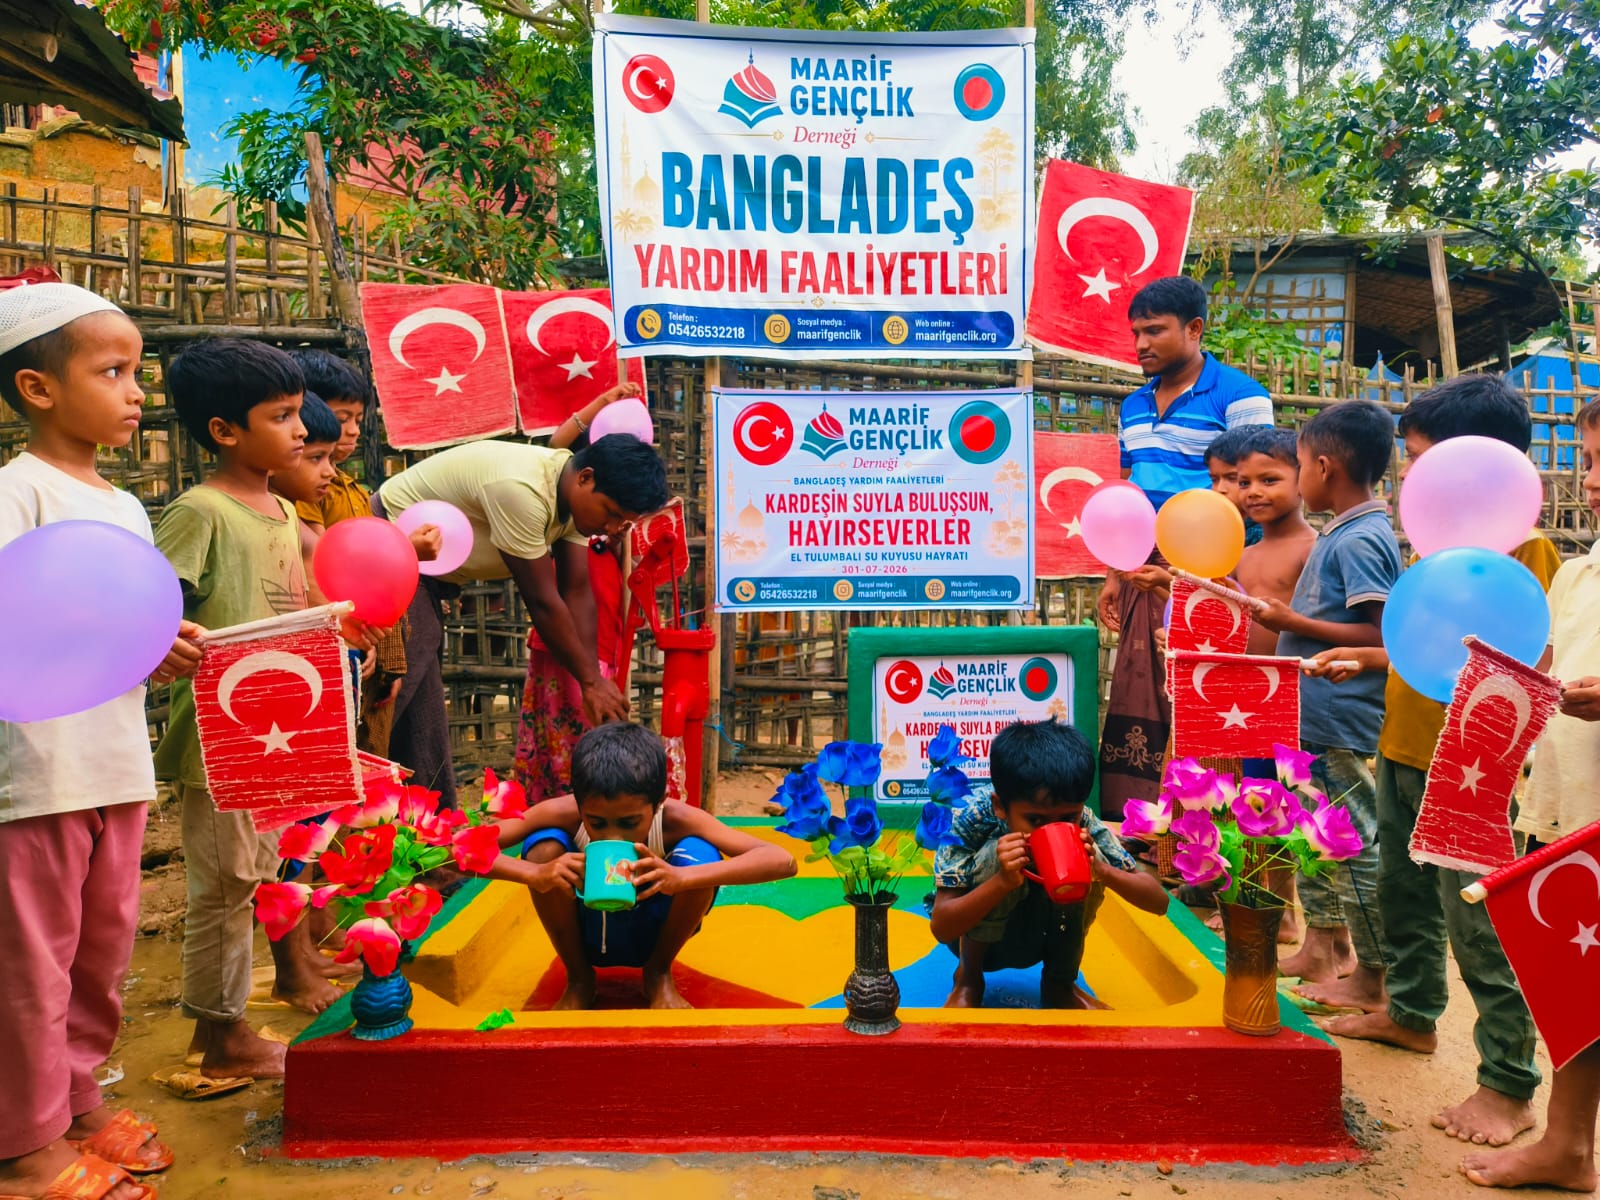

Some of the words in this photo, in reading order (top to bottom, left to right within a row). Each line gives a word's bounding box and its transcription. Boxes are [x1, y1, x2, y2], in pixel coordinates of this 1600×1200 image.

[790, 54, 893, 82] MAARİF
[790, 81, 915, 124] GENÇLİK
[793, 126, 857, 150] Derneği
[661, 151, 975, 246] BANGLADEŞ
[633, 243, 768, 294] YARDIM
[781, 242, 1009, 296] FAALİYETLERİ
[668, 311, 694, 322] Telefon
[797, 317, 820, 328] Sosyal
[821, 318, 842, 328] medya
[915, 319, 930, 328] Web
[930, 319, 950, 328] online
[668, 322, 746, 340] 05426532218
[797, 329, 862, 342] maarifgenclik
[915, 330, 997, 344] maarifgenclik.org
[849, 403, 930, 425] MAARİF
[850, 425, 944, 456] GENÇLİK
[852, 456, 899, 472] Derneği
[793, 477, 847, 487] BANGLADEŞ
[849, 476, 883, 485] YARDIM
[886, 474, 944, 485] FAALİYETLERİ
[765, 488, 848, 518] KARDEŞİN
[853, 491, 904, 513] SUYLA
[909, 491, 994, 518] BULUŞSUN,
[788, 518, 972, 547] HAYIRSEVERLER
[790, 553, 802, 562] EL
[805, 552, 861, 562] TULUMBALI
[865, 552, 878, 561] SU
[881, 551, 922, 561] KUYUSU
[925, 551, 968, 561] HAYRATI
[841, 565, 908, 574] 301-07-2026
[760, 589, 818, 600] 05426532218
[858, 589, 908, 600] maarifgenclik
[951, 588, 1012, 599] maarifgenclik.org
[957, 660, 1008, 676] MAARİF
[957, 676, 1016, 696] GENÇLİK
[959, 697, 988, 707] Derneği
[960, 721, 992, 736] SUYLA
